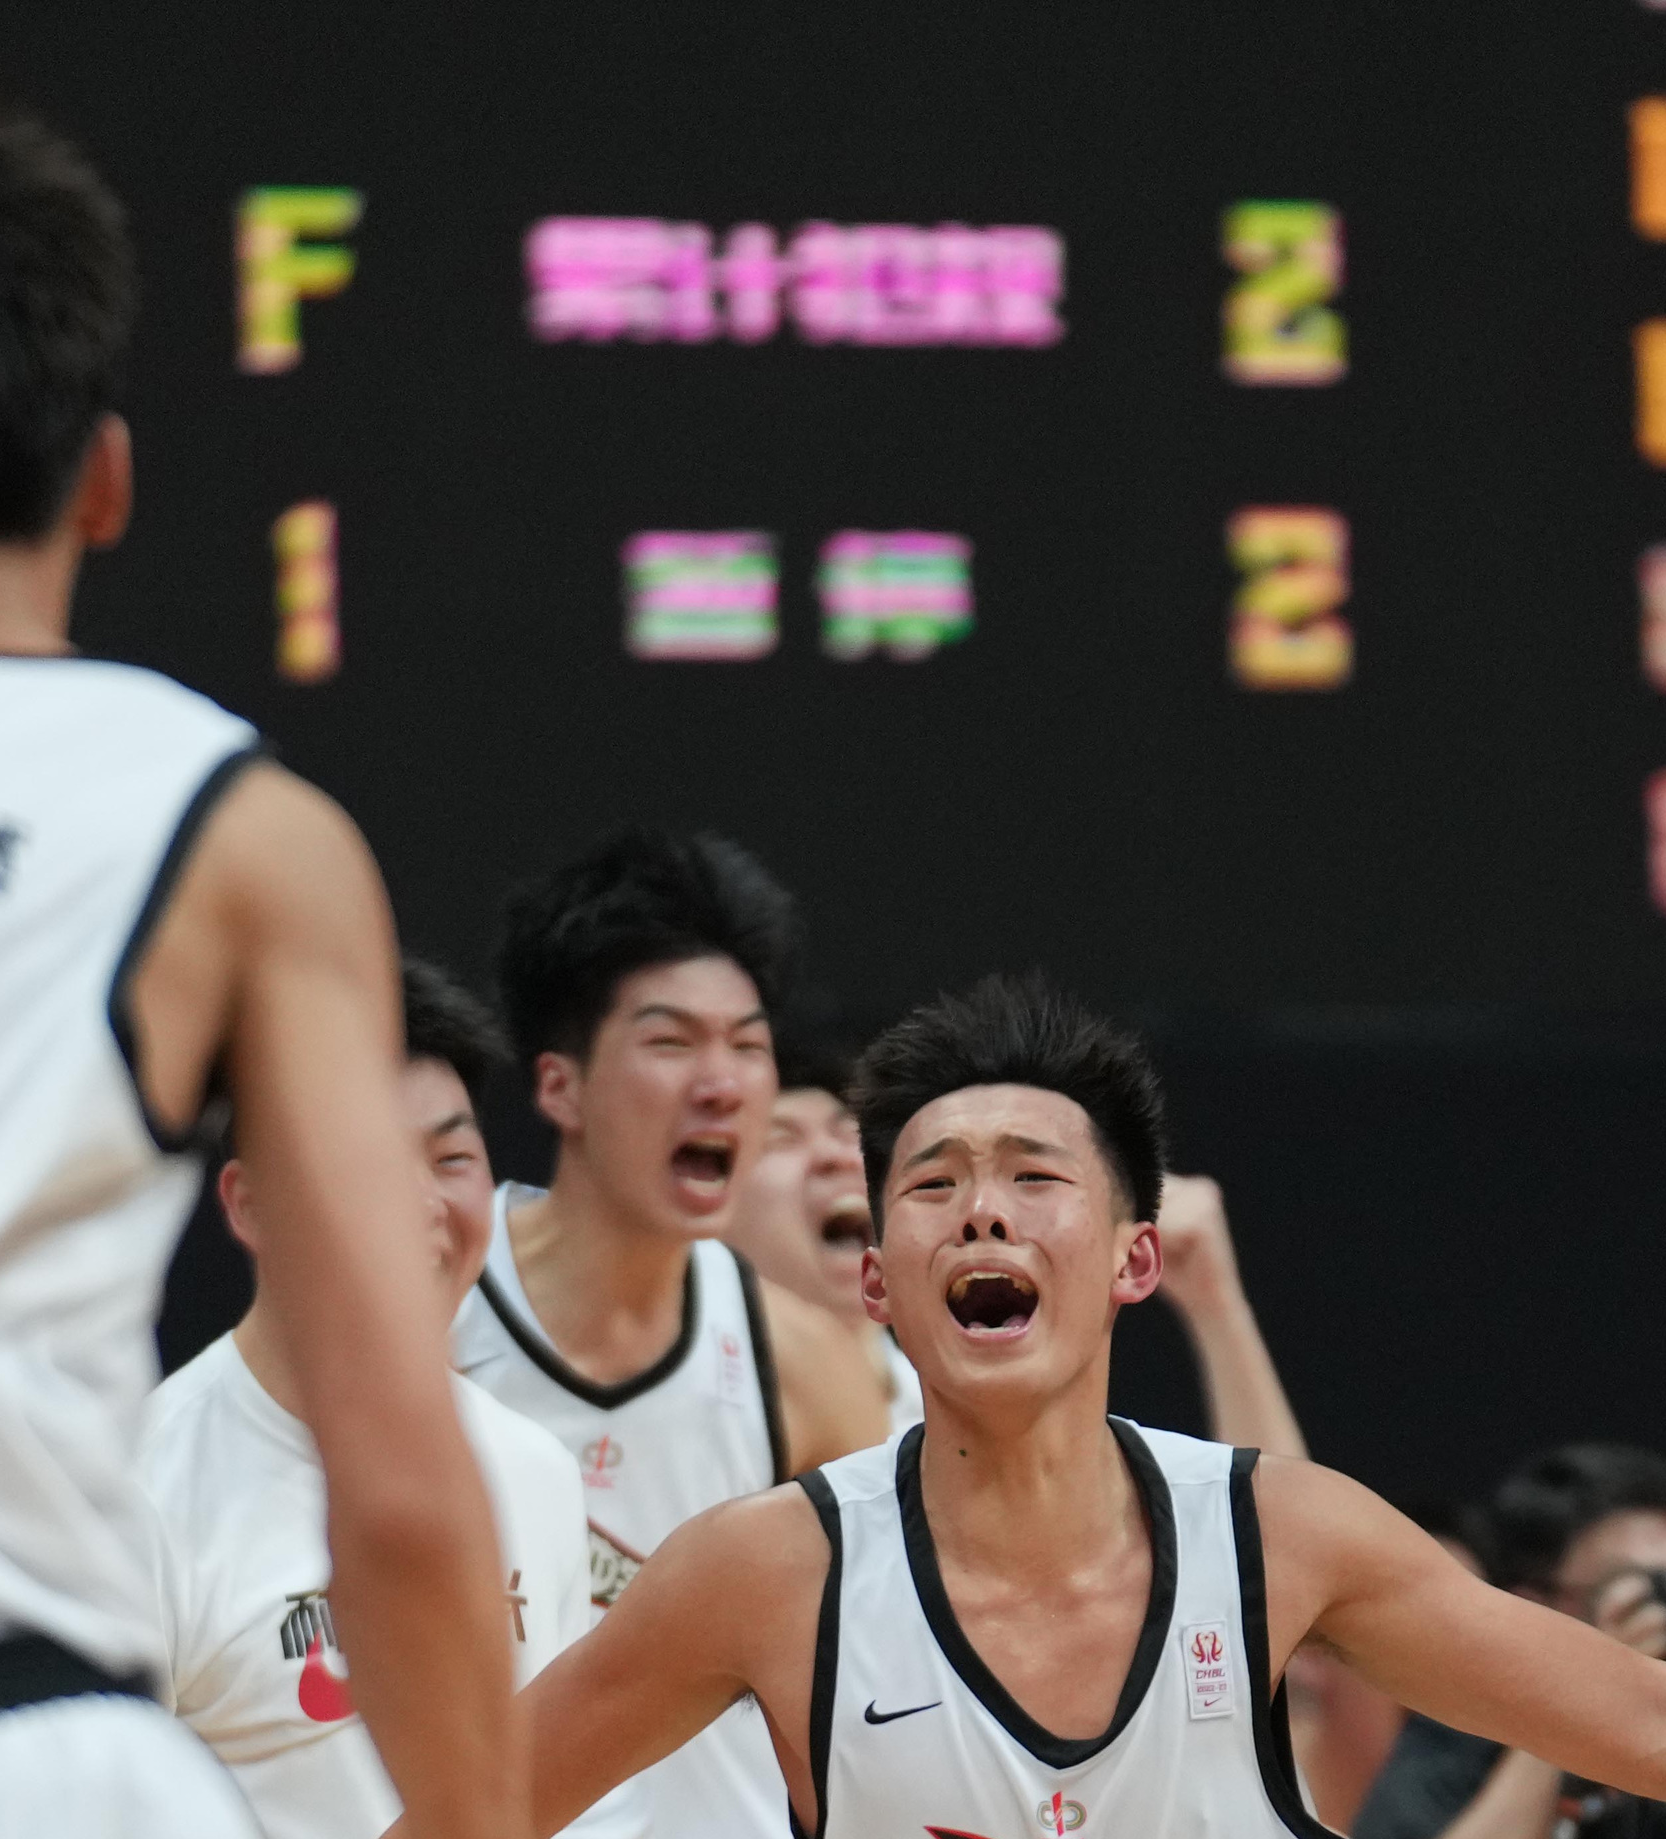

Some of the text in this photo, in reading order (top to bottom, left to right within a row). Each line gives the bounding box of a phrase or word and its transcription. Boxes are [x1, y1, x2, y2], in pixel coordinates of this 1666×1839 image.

[235, 187, 360, 373] F
[1225, 201, 1345, 386] 2
[275, 502, 339, 680] 1
[1230, 506, 1352, 688] 2
